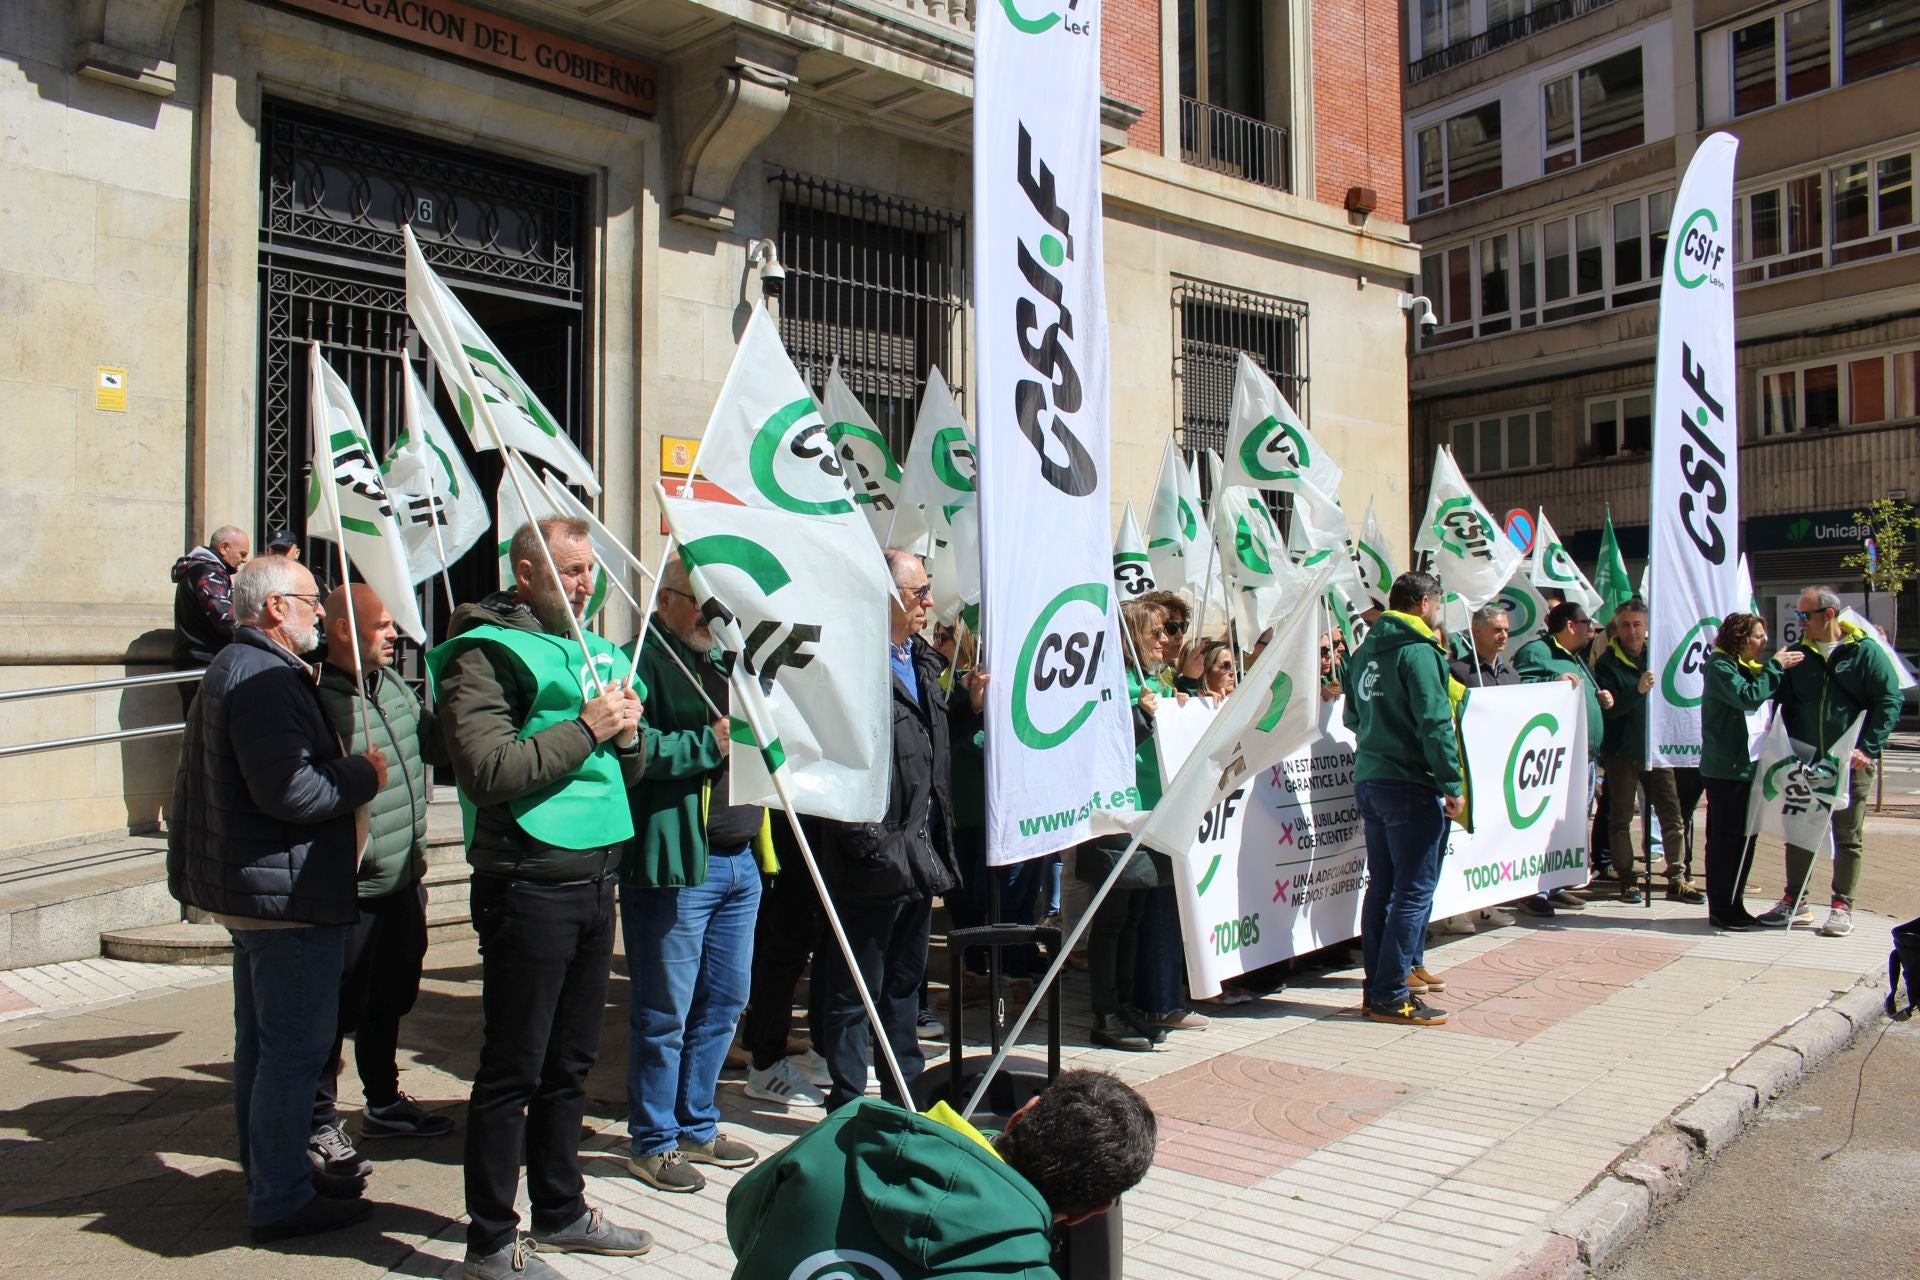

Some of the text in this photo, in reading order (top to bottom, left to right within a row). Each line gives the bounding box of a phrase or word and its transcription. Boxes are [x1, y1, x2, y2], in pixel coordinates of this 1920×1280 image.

[474, 23, 527, 62] DEL
[536, 44, 656, 99] GOBIERNO
[420, 201, 431, 220] 6
[1815, 525, 1871, 541] Unicaja
[1296, 755, 1338, 773] ESTATUTO
[1519, 747, 1566, 790] CSIF
[1285, 774, 1334, 793] GARANTICE
[1335, 773, 1349, 786] LA
[1294, 816, 1312, 831] UNA
[1298, 827, 1353, 850] COEFICIENTES
[1293, 872, 1314, 888] UNA
[1315, 856, 1365, 884] ADECUACIÓN
[1324, 885, 1330, 899] Y
[1214, 912, 1259, 956] TOD@S
